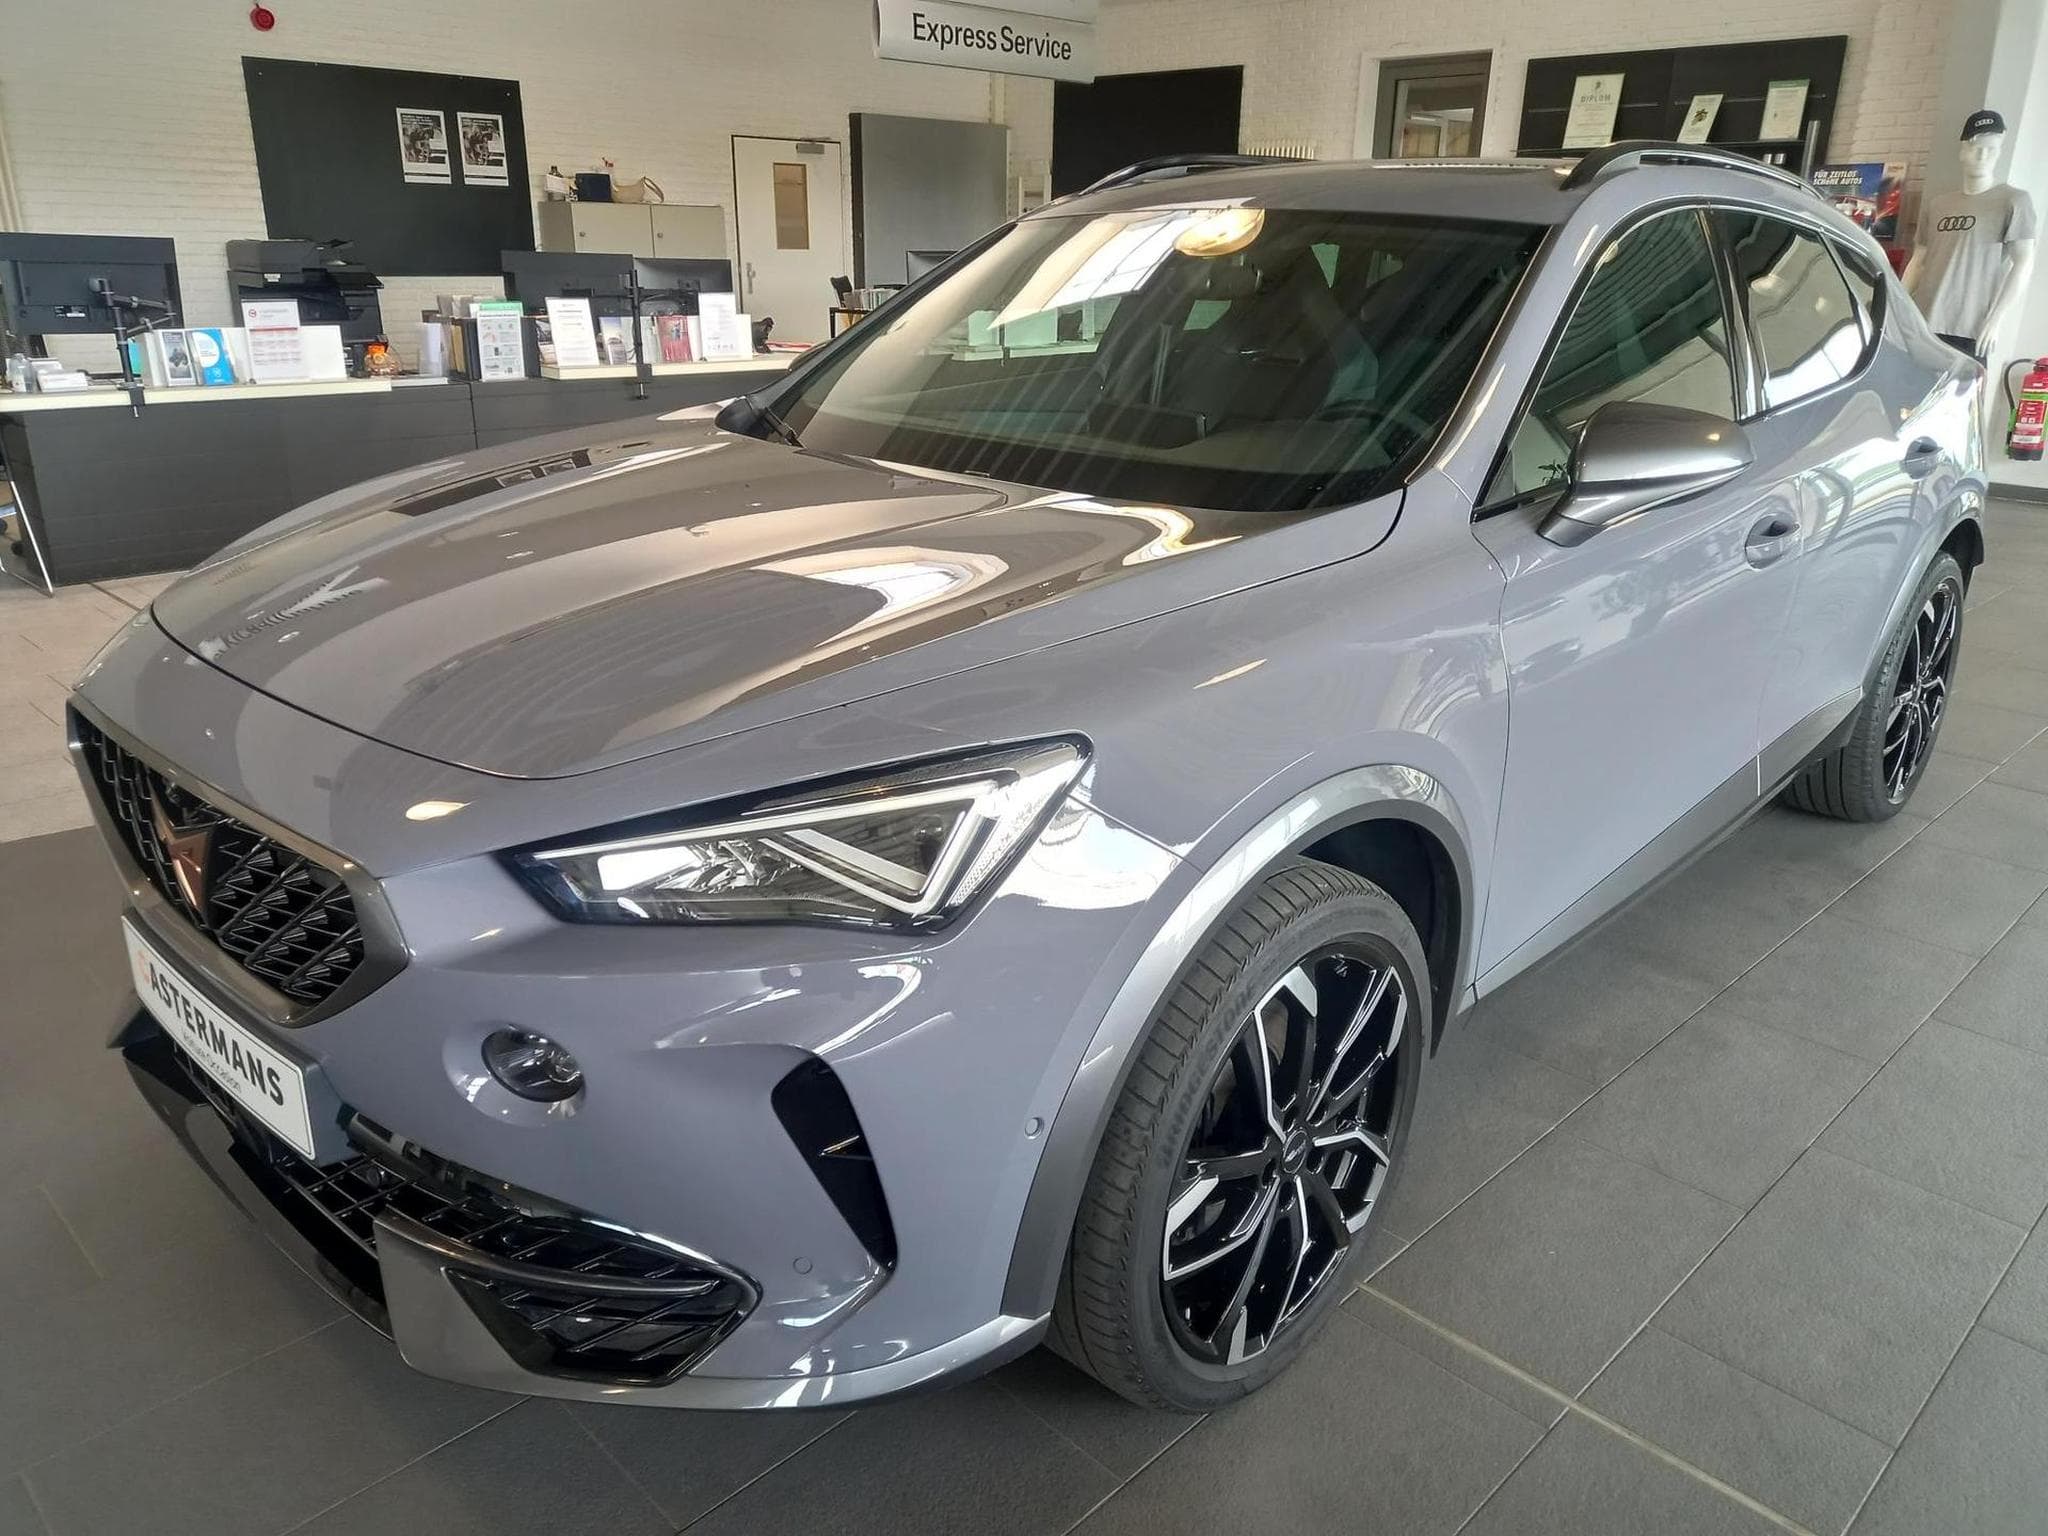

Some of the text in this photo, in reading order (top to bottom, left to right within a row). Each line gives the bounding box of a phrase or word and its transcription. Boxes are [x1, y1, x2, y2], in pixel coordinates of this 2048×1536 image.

[912, 12, 1072, 60] Express Service
[1814, 169, 1858, 179] FÜR ZEITLOS
[1840, 177, 1863, 186] AUTOS
[149, 962, 284, 1106] ASTERMANS
